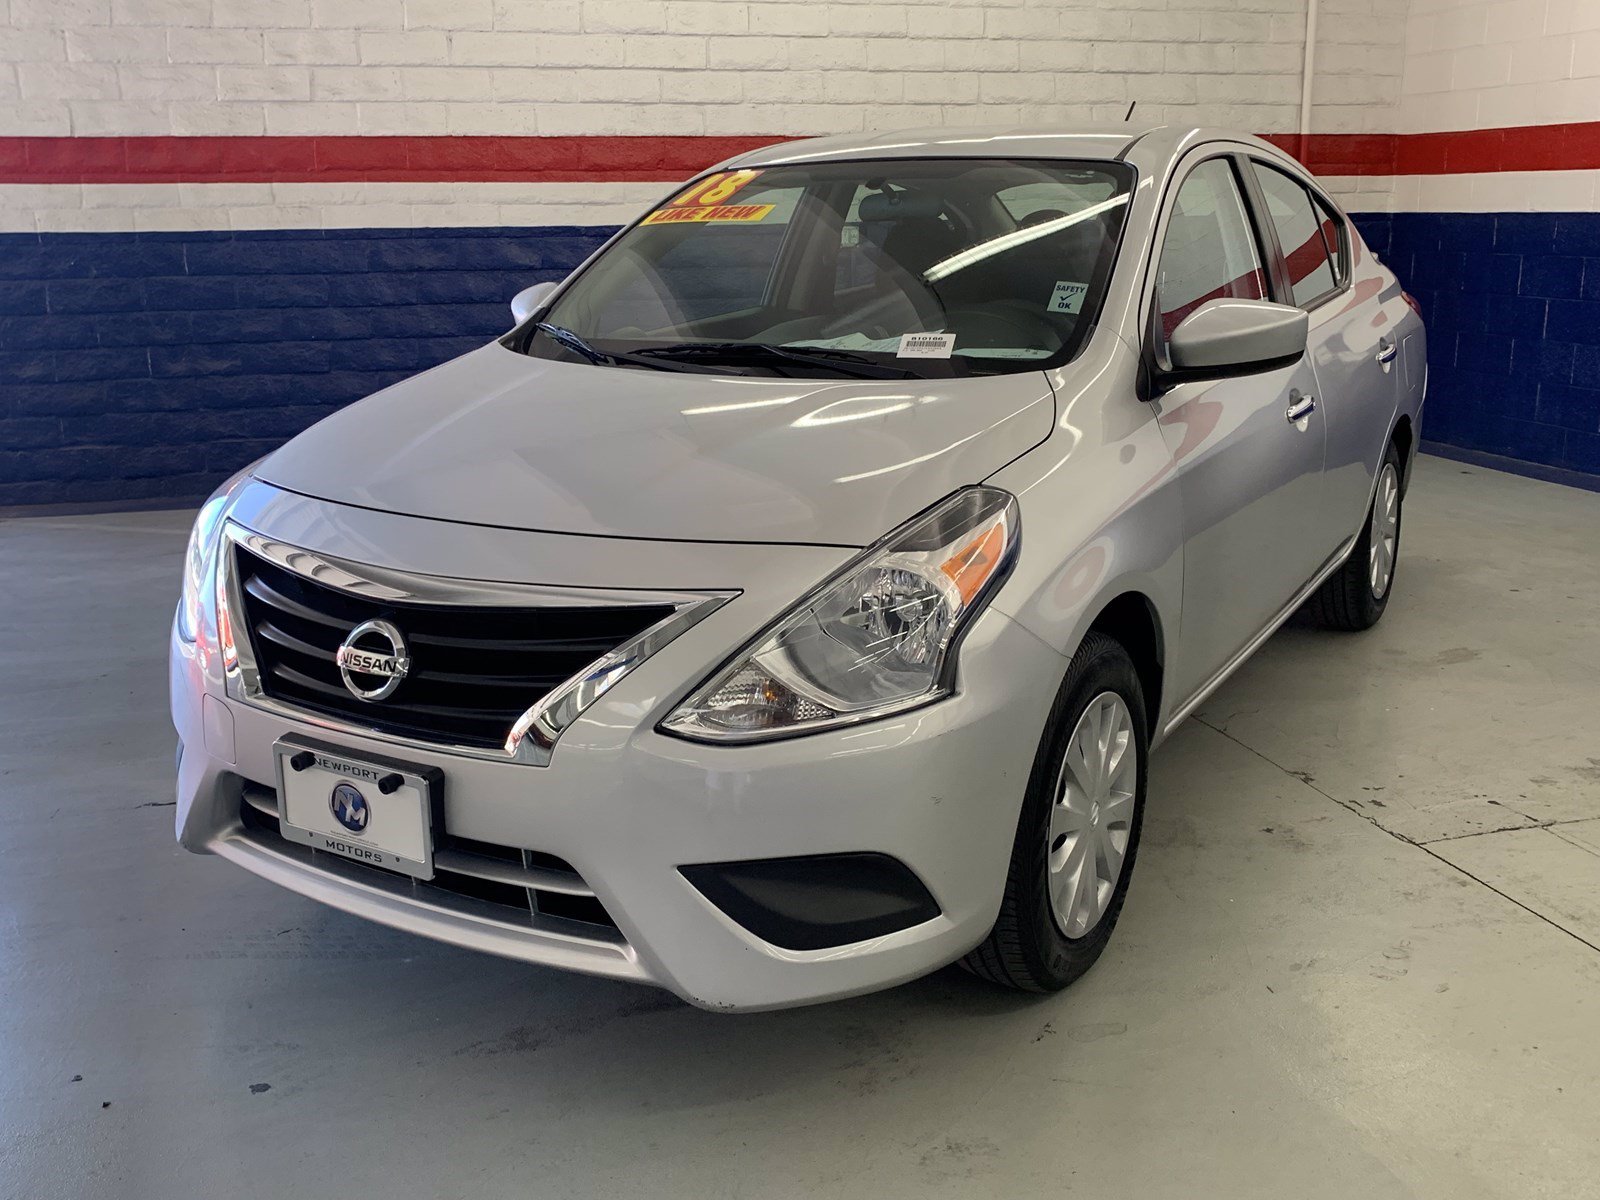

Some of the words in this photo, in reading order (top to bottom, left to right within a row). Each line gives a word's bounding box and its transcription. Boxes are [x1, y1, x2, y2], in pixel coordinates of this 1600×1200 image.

[672, 170, 757, 205] 18
[648, 207, 706, 222] LIKE
[701, 206, 768, 220] NEW
[1056, 285, 1086, 293] SAFETY
[341, 652, 397, 673] NISSAN
[315, 757, 379, 780] NEWPORT
[325, 839, 383, 863] MOTORS
